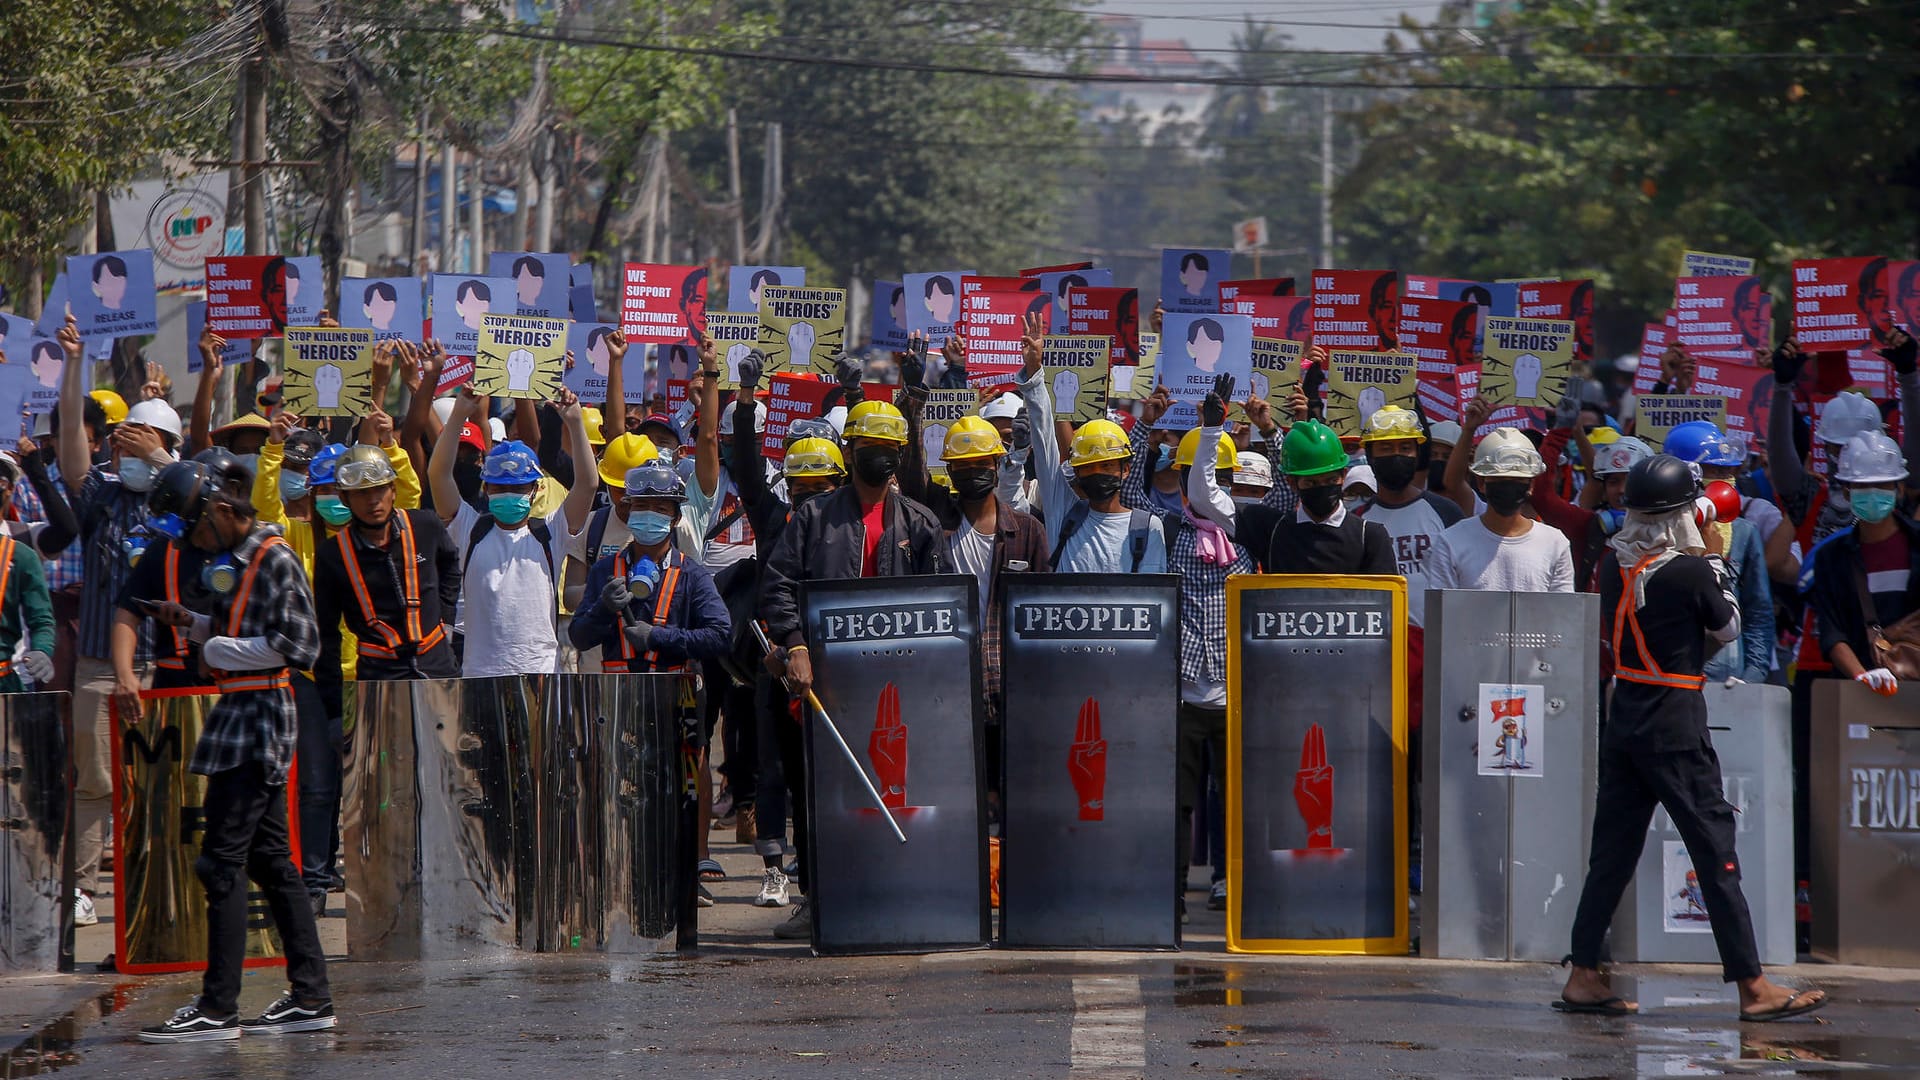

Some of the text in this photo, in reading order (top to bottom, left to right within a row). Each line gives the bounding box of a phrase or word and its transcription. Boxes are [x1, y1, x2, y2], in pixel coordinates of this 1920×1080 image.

[208, 263, 227, 276] WE
[1795, 267, 1818, 282] WE
[627, 270, 646, 283] WE
[209, 279, 252, 290] SUPPORT
[1314, 277, 1334, 290] WE
[1408, 280, 1425, 291] WE
[1679, 283, 1698, 295] WE
[626, 286, 671, 298] SUPPORT
[764, 288, 842, 302] STOP KILLING OUR
[1522, 290, 1540, 303] WE
[1796, 284, 1848, 298] SUPPORT
[209, 293, 229, 303] OUR
[625, 299, 645, 309] OUR
[971, 297, 990, 310] WE
[1071, 293, 1087, 305] WE
[1314, 294, 1360, 305] SUPPORT
[1679, 298, 1725, 308] SUPPORT
[210, 305, 261, 317] LEGITIMATE
[768, 302, 837, 319] “HEROES”
[1236, 301, 1255, 314] WE
[1401, 303, 1420, 317] WE
[1522, 304, 1562, 317] SUPPORT
[1796, 301, 1819, 312] OUR
[94, 311, 136, 323] RELEASE
[516, 309, 549, 317] ELEASE
[624, 311, 678, 323] LEGITIMATE
[970, 313, 1016, 325] SUPPORT
[1071, 309, 1109, 320] SUPPORT
[1314, 308, 1334, 318] OUR
[484, 316, 564, 331] STOP KILLING OUR
[706, 315, 758, 324] STOP KILLING
[1797, 313, 1857, 328] LEGITIMATE
[624, 325, 688, 337] GOVERNMENT
[928, 326, 955, 334] RELEA
[970, 326, 990, 337] OUR
[1071, 322, 1088, 331] OUR
[1314, 321, 1368, 332] LEGITIMATE
[1400, 320, 1443, 334] SUPPORT
[1489, 320, 1570, 333] STOP KILLING OUR
[1678, 322, 1732, 333] LEGITIMATE
[288, 331, 369, 342] STOP KILLING OUR
[374, 332, 403, 340] LEASE
[455, 332, 478, 341] RELE
[487, 328, 559, 347] “HEROES”
[708, 326, 759, 341] “HEROE
[1141, 335, 1157, 343] OUR
[1647, 329, 1665, 343] WE
[1678, 334, 1743, 345] GOVERNMENT
[1797, 328, 1871, 343] GOVERNMENT
[969, 340, 1022, 351] LEGITIMATE
[1053, 339, 1085, 349] KILLING
[1087, 340, 1105, 349] OUR
[1313, 335, 1379, 346] GOVERNMENT
[1492, 333, 1565, 351] “HEROES”
[292, 344, 364, 360] “HEROES”
[1251, 341, 1299, 354] ILLING OUR
[968, 352, 1024, 365] GOVERNME
[1042, 351, 1101, 367] HEROES”
[1251, 353, 1294, 371] ROES”
[1333, 353, 1413, 367] STOP KILLING OUR
[1337, 366, 1408, 385] “HEROES”
[1458, 371, 1479, 385] WE
[1698, 365, 1719, 381] WE
[585, 379, 607, 387] RELE
[1187, 375, 1216, 384] RELEA
[669, 386, 685, 397] WE
[772, 381, 789, 396] WE
[32, 391, 59, 399] RELEA
[927, 392, 975, 402] ILLING OUR
[770, 398, 812, 413] SUPPORT
[1640, 398, 1722, 409] STOP KILLING OUR
[768, 411, 787, 423] OUR
[1173, 408, 1197, 416] RELE
[1396, 534, 1431, 561] EP
[1399, 561, 1421, 575] RIT
[825, 609, 953, 640] PEOPLE
[1024, 607, 1151, 631] PEOPLE
[1256, 611, 1384, 636] PEOPLE
[1850, 767, 1920, 829] PEOP
